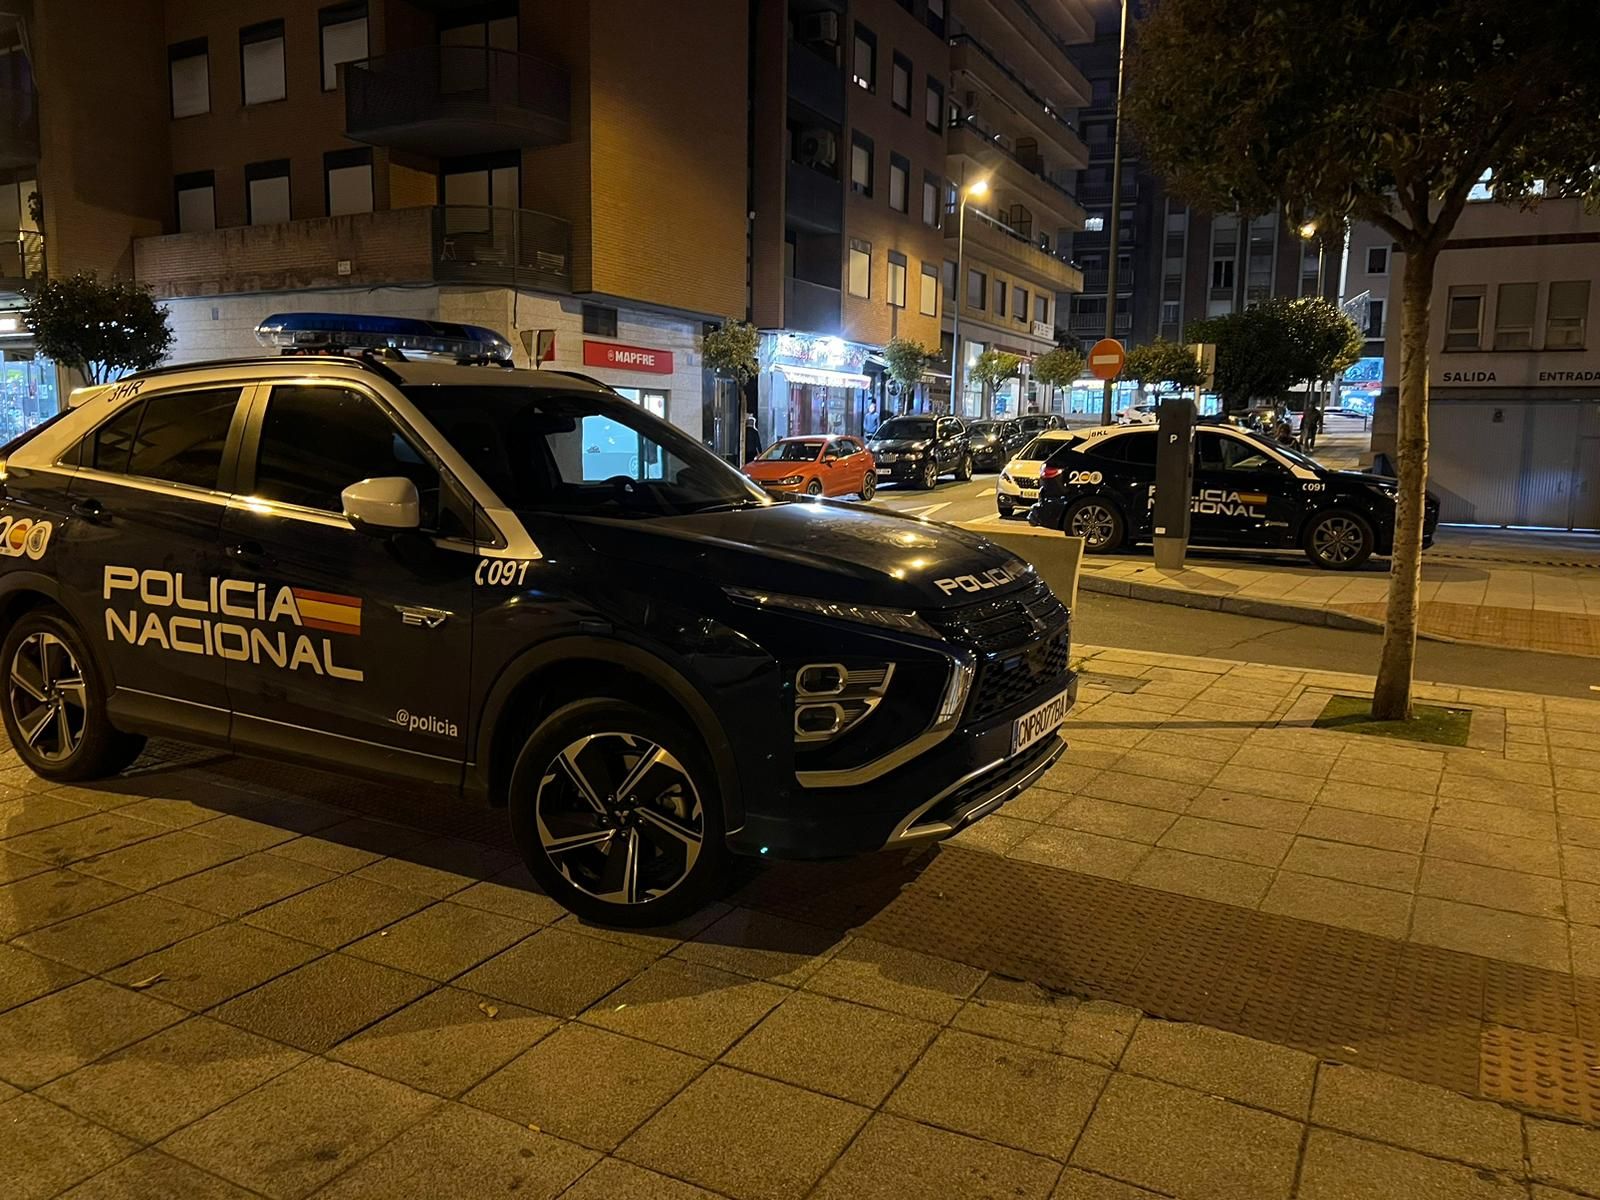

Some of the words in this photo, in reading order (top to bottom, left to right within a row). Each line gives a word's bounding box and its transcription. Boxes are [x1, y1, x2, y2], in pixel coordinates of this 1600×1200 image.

[615, 350, 655, 366] MAPFRE
[1443, 372, 1496, 382] SALIDA
[1539, 371, 1600, 382] ENTRADA
[1169, 434, 1178, 443] P
[1307, 482, 1326, 492] 091
[487, 560, 530, 586] 091
[105, 607, 364, 682] NACIONAL
[396, 709, 458, 737] @policia
